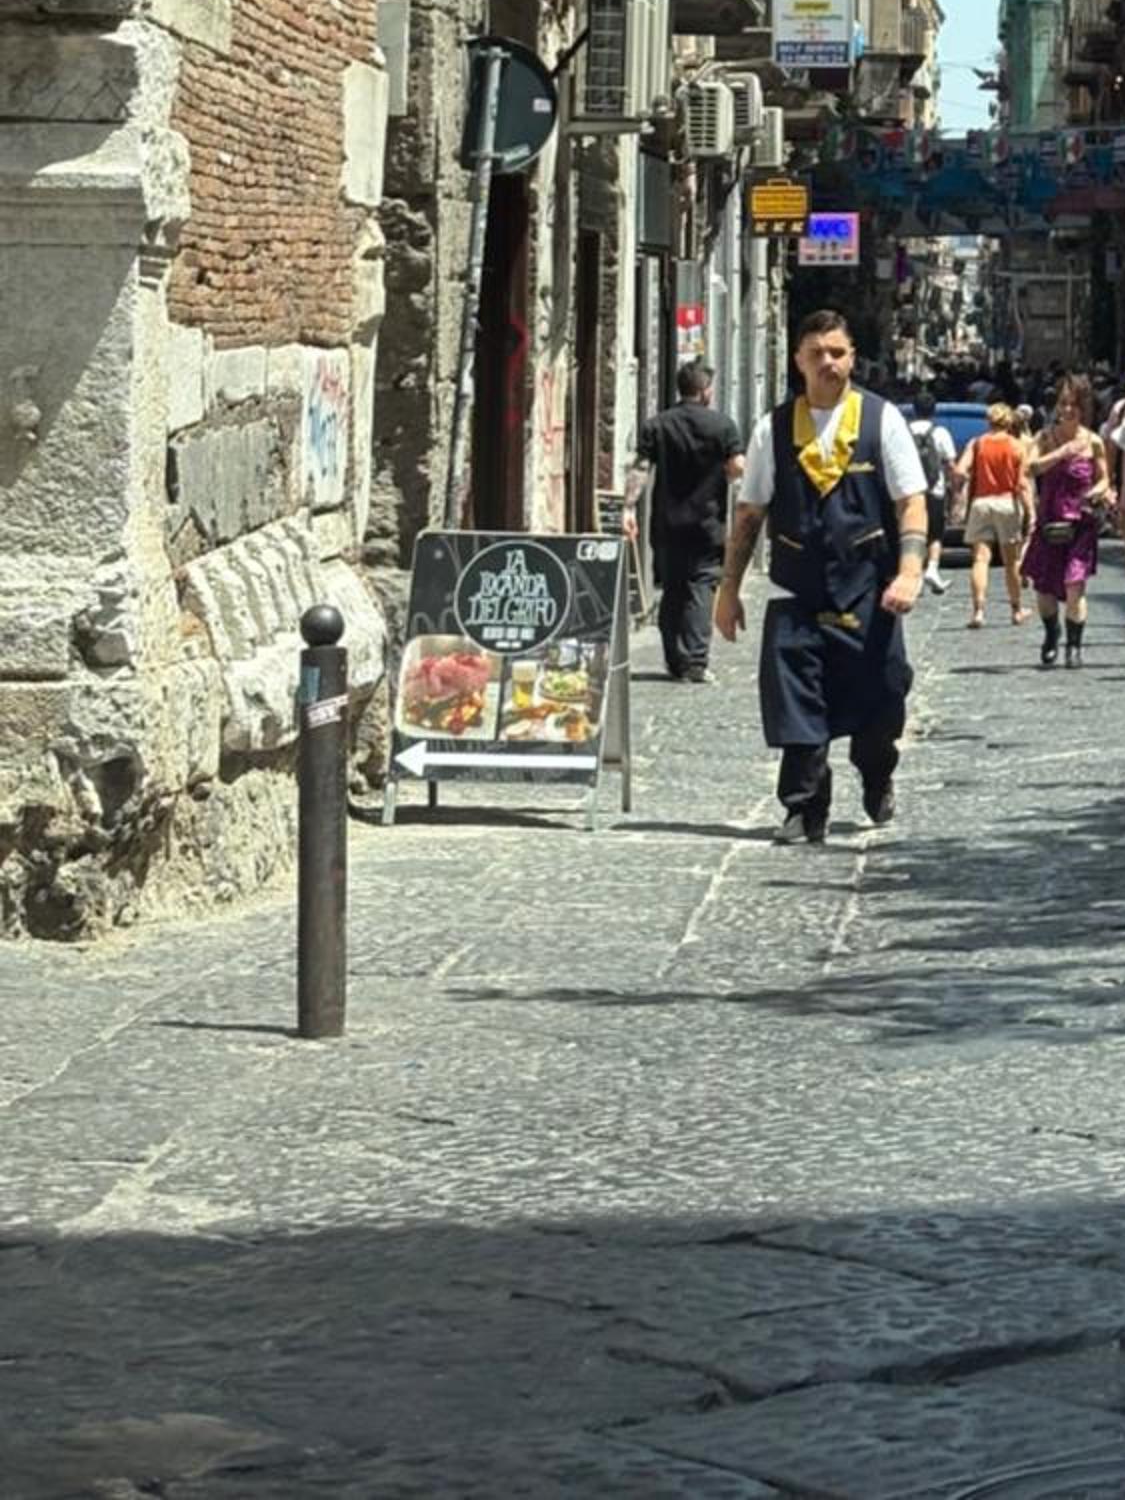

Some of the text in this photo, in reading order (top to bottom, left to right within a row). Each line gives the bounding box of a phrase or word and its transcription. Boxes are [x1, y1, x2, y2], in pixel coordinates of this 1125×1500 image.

[506, 548, 529, 573] LA
[478, 570, 550, 598] LOCANDA
[464, 596, 501, 626] DEL
